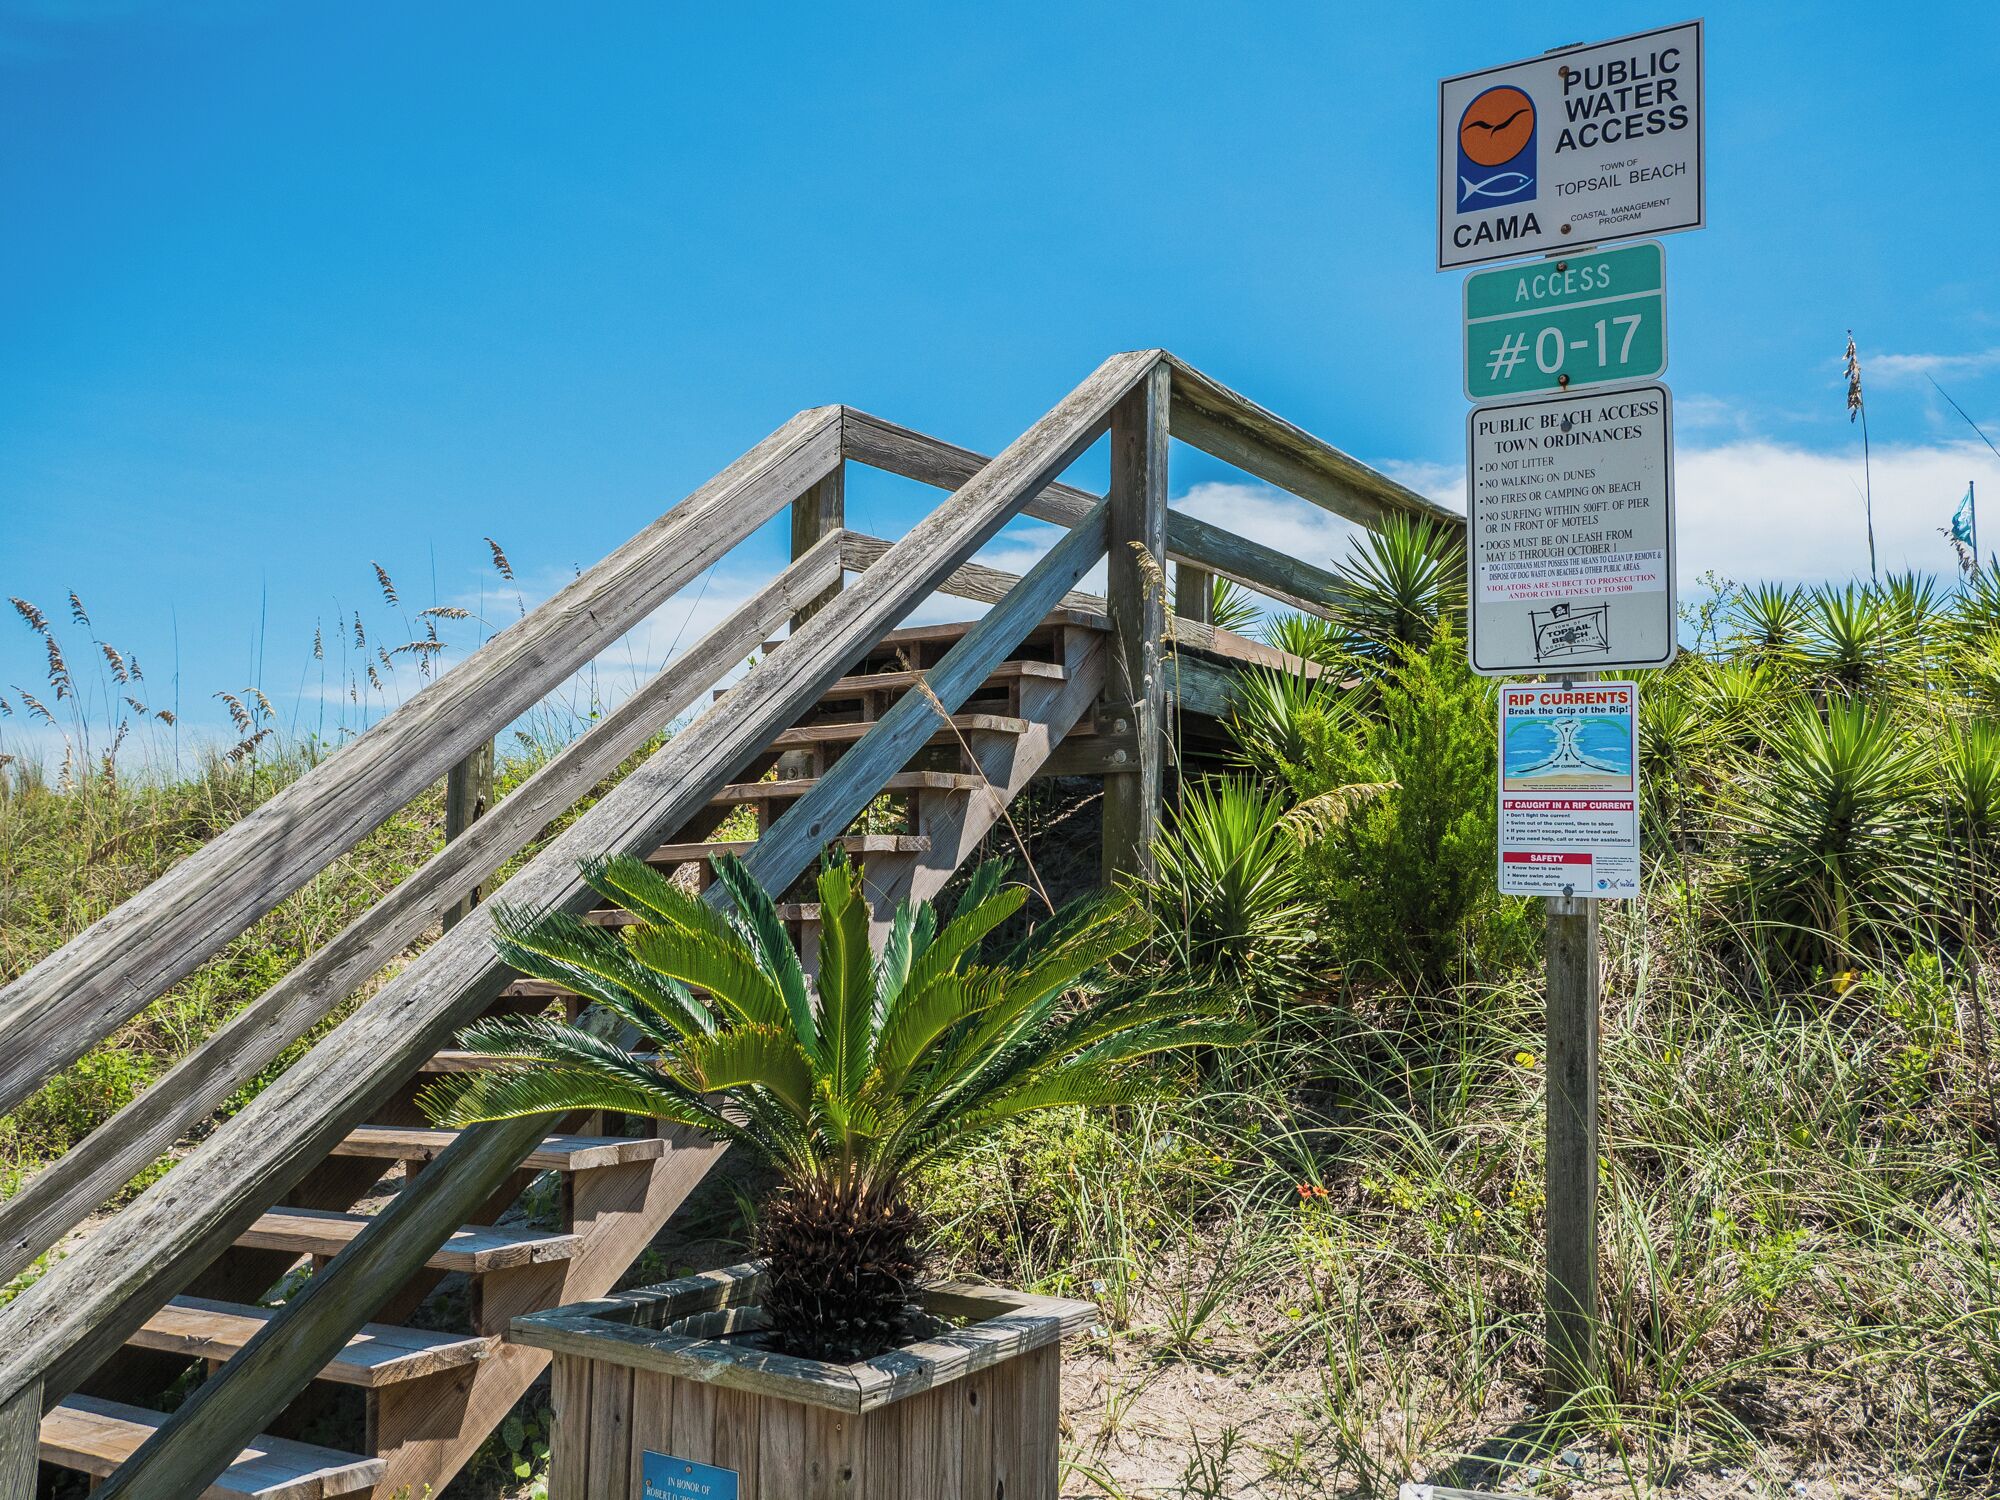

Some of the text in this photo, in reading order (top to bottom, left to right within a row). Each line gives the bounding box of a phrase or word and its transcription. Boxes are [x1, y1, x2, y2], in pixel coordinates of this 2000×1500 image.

[1563, 48, 1680, 95] PUBLIC
[1564, 77, 1679, 122] WATER
[1554, 104, 1688, 153] ACCESS
[1600, 158, 1638, 171] TOWN OF
[1555, 162, 1686, 196] TOPSAIL BEACH
[1570, 198, 1671, 222] COASTAL MANAGEMENT
[1598, 212, 1642, 224] PROGRAM
[1453, 212, 1542, 248] CAMA
[1514, 264, 1610, 302] ACCESS
[1485, 314, 1642, 380] #0-17
[1479, 416, 1534, 436] PUBLIC
[1598, 400, 1659, 422] ACCESS
[1494, 425, 1642, 454] TOWN ORDINANCES
[1485, 456, 1554, 472] DO NOT LITTER
[1485, 468, 1596, 488] NO WALKING ON DUNES
[1485, 481, 1641, 505] NO FIRES OR CAMPING ON BEACH
[1485, 498, 1650, 522] NO SURFING WITHIN 500FT. OF PIER
[1486, 515, 1598, 534] OR IN FRONT OF MOTELS
[1486, 529, 1632, 550] DOGS MUST BE ON LEASH FROM
[1486, 551, 1506, 562] MAY
[1510, 551, 1516, 560] 15
[1518, 548, 1564, 560] THROUGH
[1568, 544, 1610, 556] OCTOBER
[1502, 562, 1532, 570] CUSTODIANS
[1534, 560, 1546, 568] MUST
[1548, 558, 1568, 568] POSSESS
[1570, 558, 1580, 566] THE
[1581, 556, 1598, 565] MEANS
[1600, 556, 1606, 564] TO
[1608, 554, 1624, 562] CLEAN
[1634, 552, 1656, 560] REMOVE
[1490, 572, 1509, 580] DISPOSE
[1510, 572, 1517, 580] OF
[1518, 570, 1530, 578] DOG
[1530, 570, 1546, 578] WASTE
[1548, 569, 1556, 578] ON
[1556, 568, 1578, 576] BEACHES
[1584, 566, 1602, 574] OTHER
[1604, 564, 1622, 573] PUBLIC
[1487, 583, 1532, 592] VIOLATORS
[1586, 578, 1596, 586] TO
[1598, 574, 1656, 584] PROSECUTION
[1508, 592, 1538, 600] AND/OR
[1540, 590, 1564, 598] CIVIL
[1565, 588, 1589, 596] FINES
[1616, 584, 1633, 592] $100
[1546, 624, 1592, 638] TOPSAIL
[1552, 631, 1588, 644] BECH
[1572, 636, 1599, 644] AROLINA
[1508, 692, 1628, 706] RIP CURRENTS
[1508, 706, 1535, 715] Break
[1556, 706, 1576, 716] Grip
[1591, 706, 1606, 714] the
[1609, 705, 1628, 715] Rip!
[646, 1487, 671, 1500] ROBERT
[668, 1476, 710, 1495] IN HONOR OF
